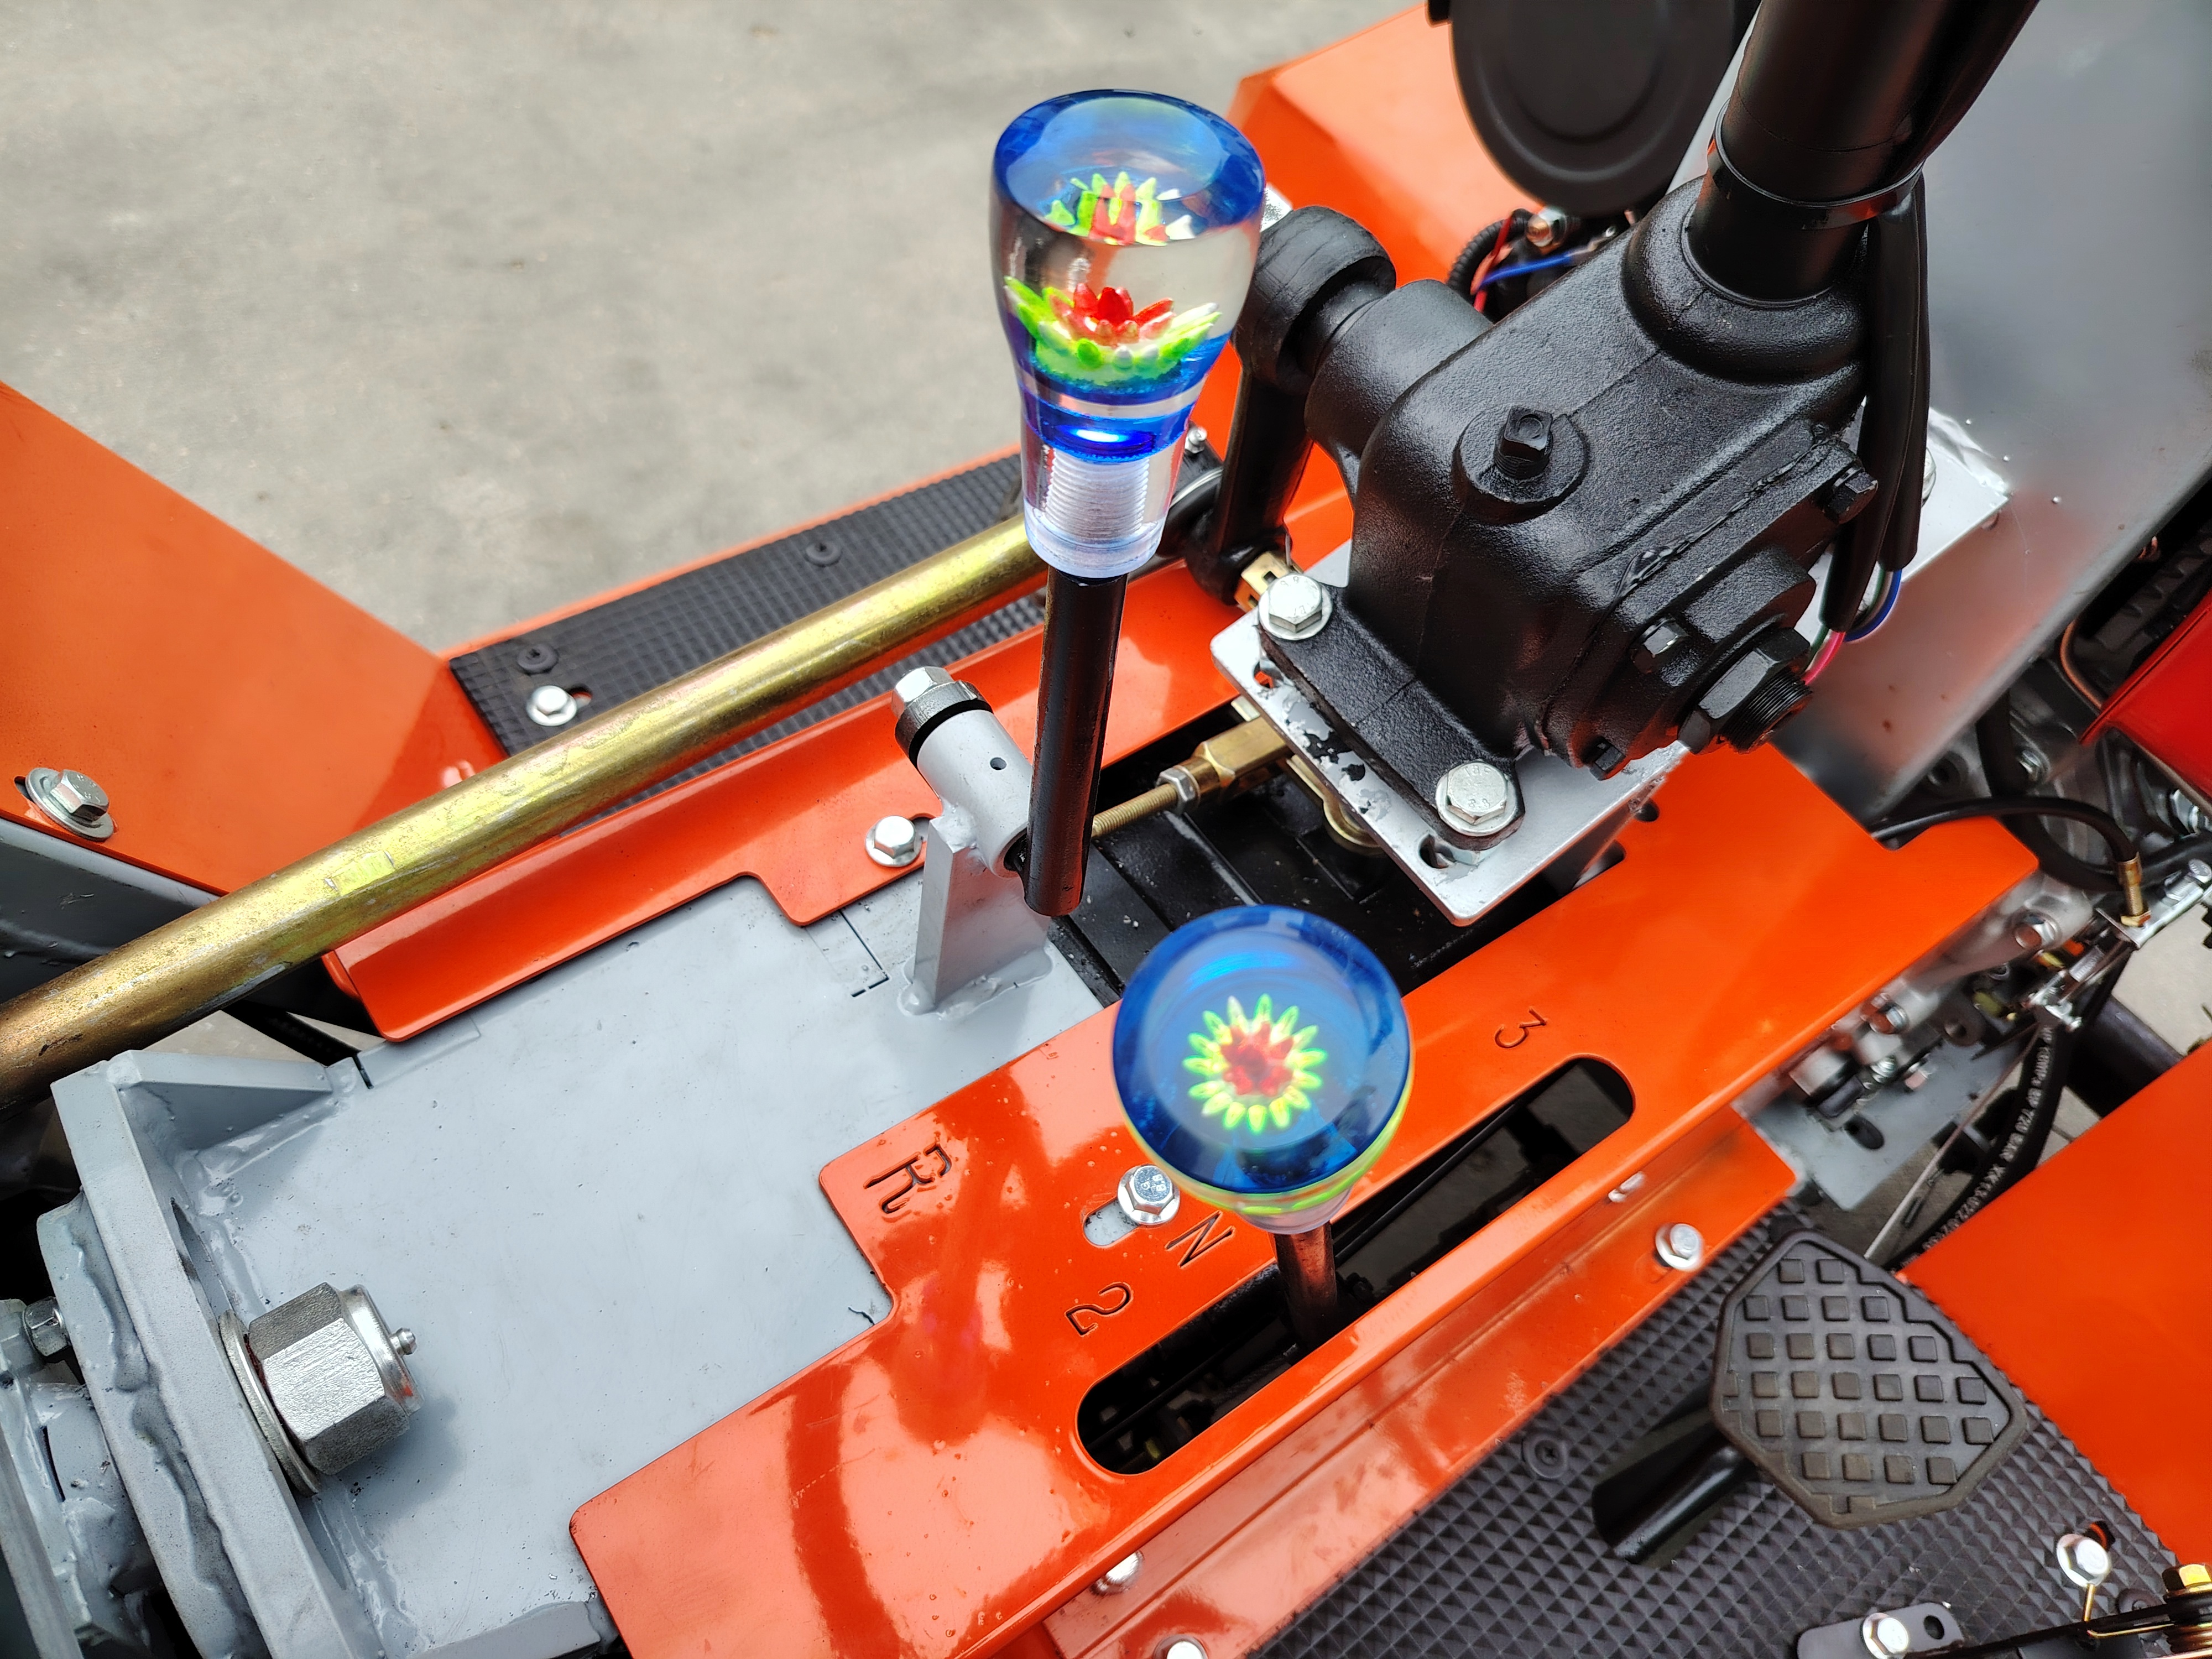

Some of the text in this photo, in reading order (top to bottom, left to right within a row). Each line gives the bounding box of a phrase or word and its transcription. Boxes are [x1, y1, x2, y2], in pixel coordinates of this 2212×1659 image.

[1494, 1007, 1548, 1049] 3
[863, 1144, 952, 1214] R
[1152, 1173, 1167, 1192] 8.8
[1165, 1210, 1236, 1268] N
[1064, 1281, 1135, 1336] 2
